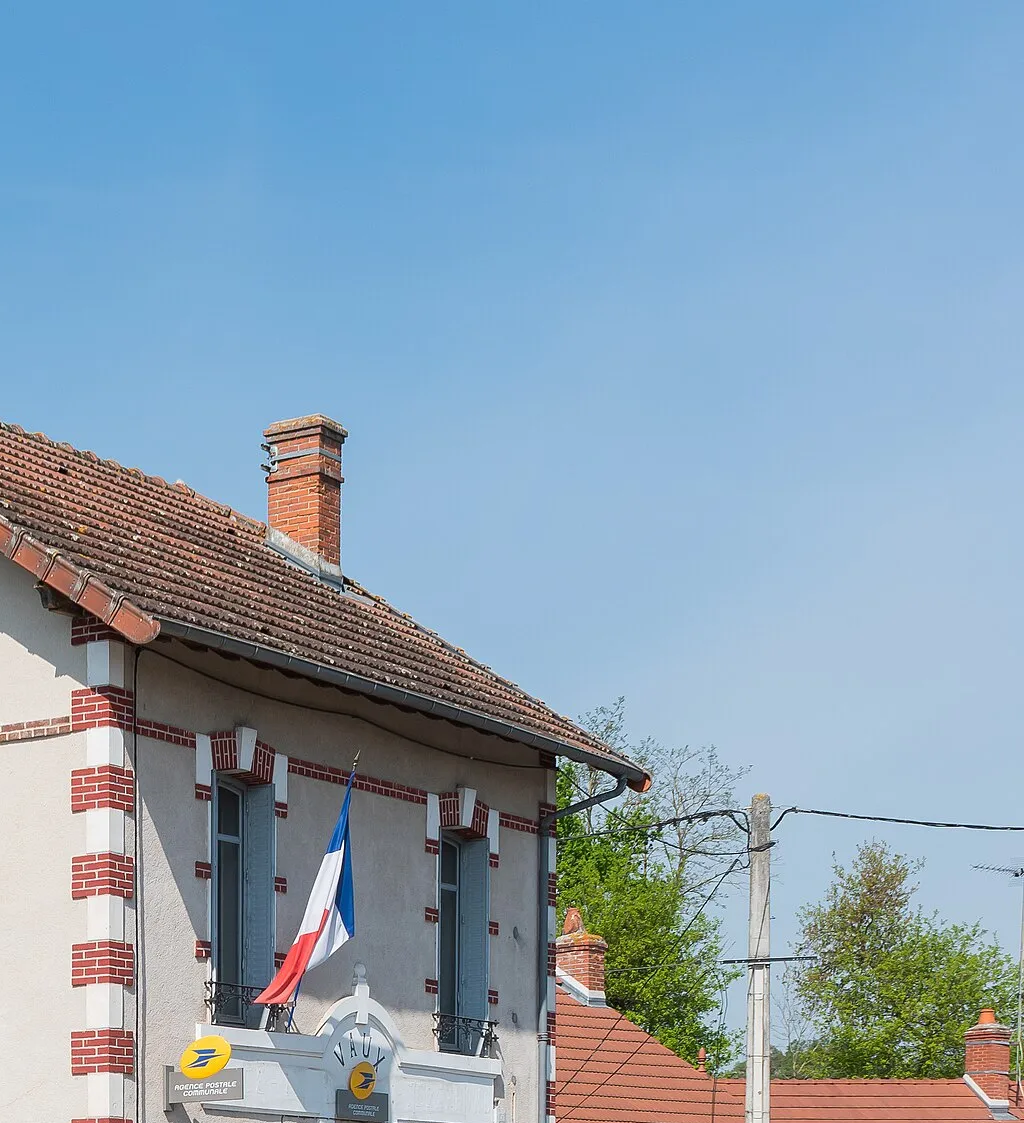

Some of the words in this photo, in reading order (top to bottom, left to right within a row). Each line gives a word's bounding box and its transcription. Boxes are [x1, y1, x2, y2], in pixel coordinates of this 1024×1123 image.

[333, 1032, 386, 1073] VAUX
[174, 1083, 204, 1091] AGENCE
[205, 1081, 237, 1089] POSTALE
[183, 1088, 228, 1097] COMMUNALE
